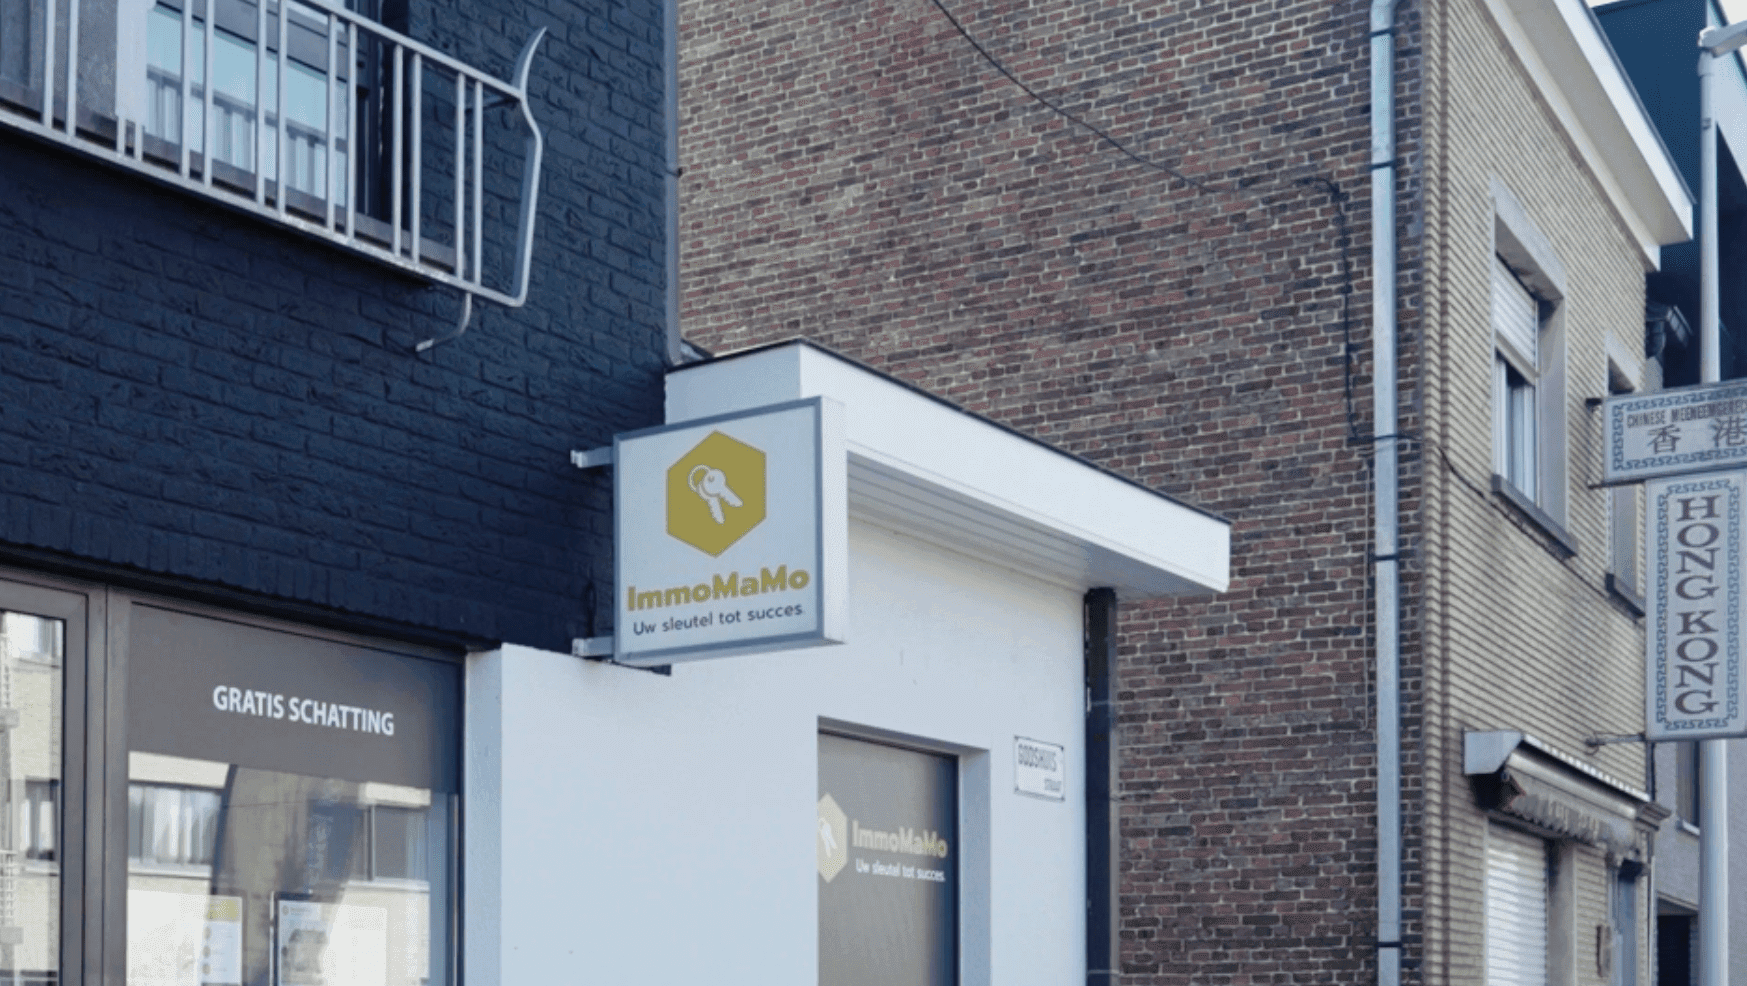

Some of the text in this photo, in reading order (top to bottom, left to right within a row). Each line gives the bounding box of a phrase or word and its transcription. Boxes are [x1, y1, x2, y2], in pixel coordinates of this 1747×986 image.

[1626, 409, 1666, 428] CHINESE
[627, 564, 810, 612] ImmoMaMo
[1674, 494, 1721, 715] HONG KONG
[632, 620, 656, 636] Uw
[662, 612, 713, 632] sleutel
[719, 610, 742, 625] tot
[213, 685, 395, 736] GRATIS SCHATTING
[852, 820, 947, 858] ImmoMaMo
[855, 858, 870, 874] Uw
[872, 860, 902, 877] sleutel
[902, 865, 915, 878] tot
